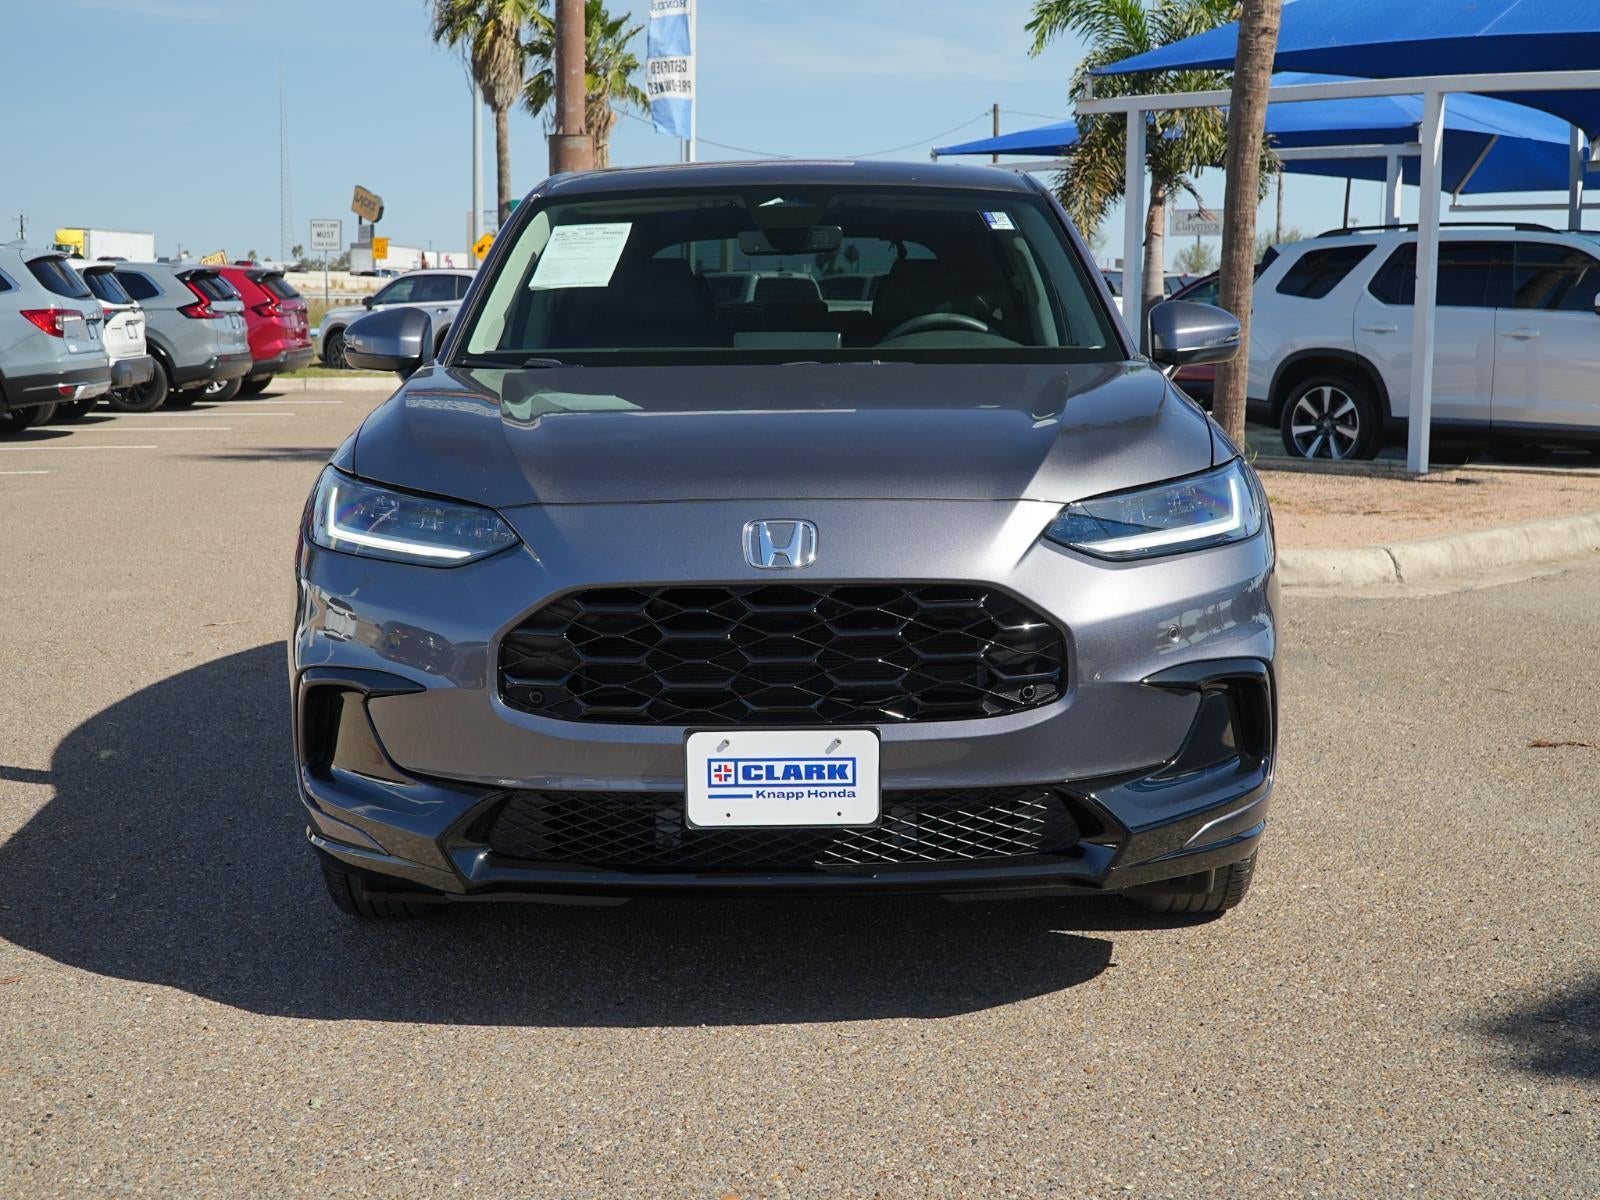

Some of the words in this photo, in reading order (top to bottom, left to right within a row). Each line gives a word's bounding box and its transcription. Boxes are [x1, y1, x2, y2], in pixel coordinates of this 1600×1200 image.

[316, 231, 335, 239] MUST
[741, 763, 849, 781] CLARK
[756, 790, 804, 800] Knapp
[807, 789, 856, 799] Honda
